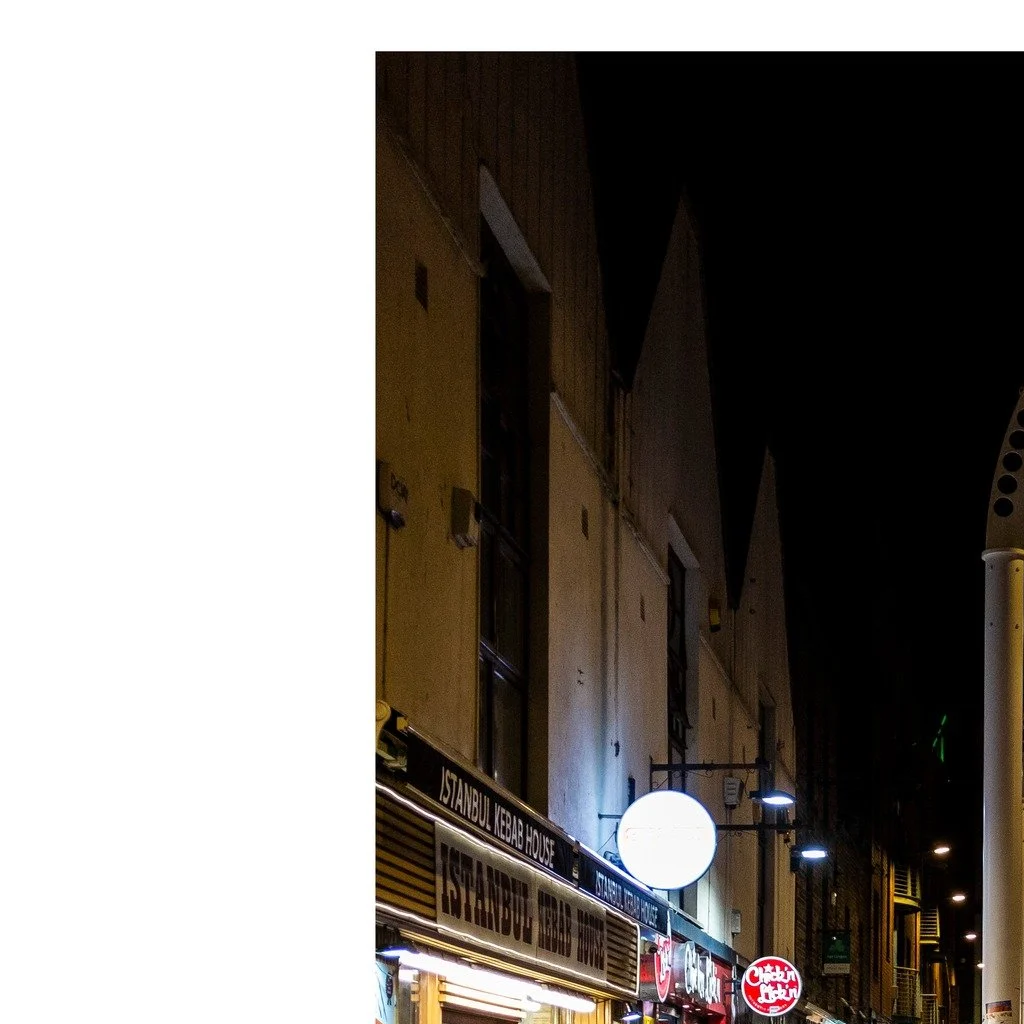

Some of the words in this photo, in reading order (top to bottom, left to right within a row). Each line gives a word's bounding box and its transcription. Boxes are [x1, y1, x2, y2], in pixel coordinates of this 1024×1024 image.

[439, 766, 491, 831] ISTANBUL
[493, 802, 524, 851] KEBAB
[525, 824, 555, 869] HOUSE
[440, 842, 533, 945] ISTANBUL
[537, 888, 572, 958] KEBAB
[576, 908, 605, 971] HOUSE
[746, 964, 797, 986] Chick'n
